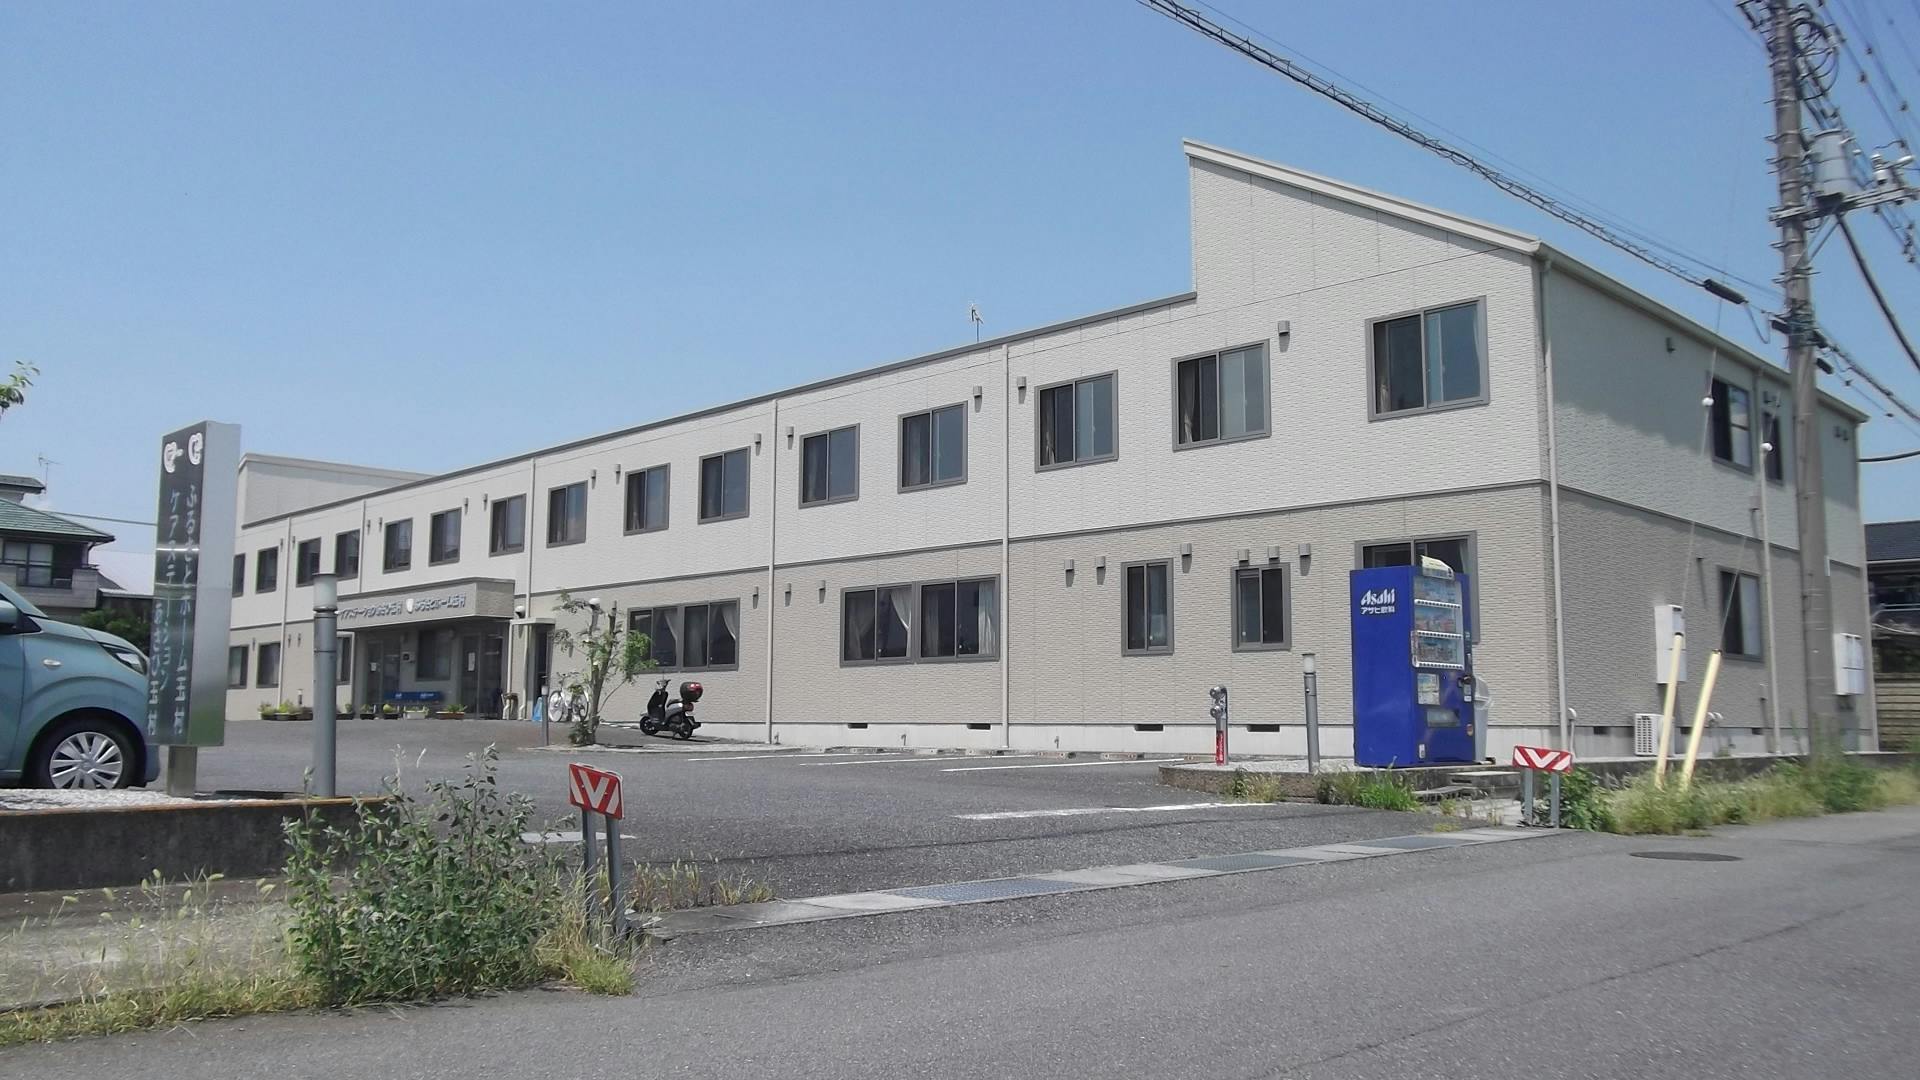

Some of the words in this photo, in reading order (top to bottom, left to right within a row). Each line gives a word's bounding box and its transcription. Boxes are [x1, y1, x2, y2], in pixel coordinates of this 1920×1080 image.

[1360, 588, 1395, 606] Asahi
[1360, 605, 1395, 615] アサヒ飲料
